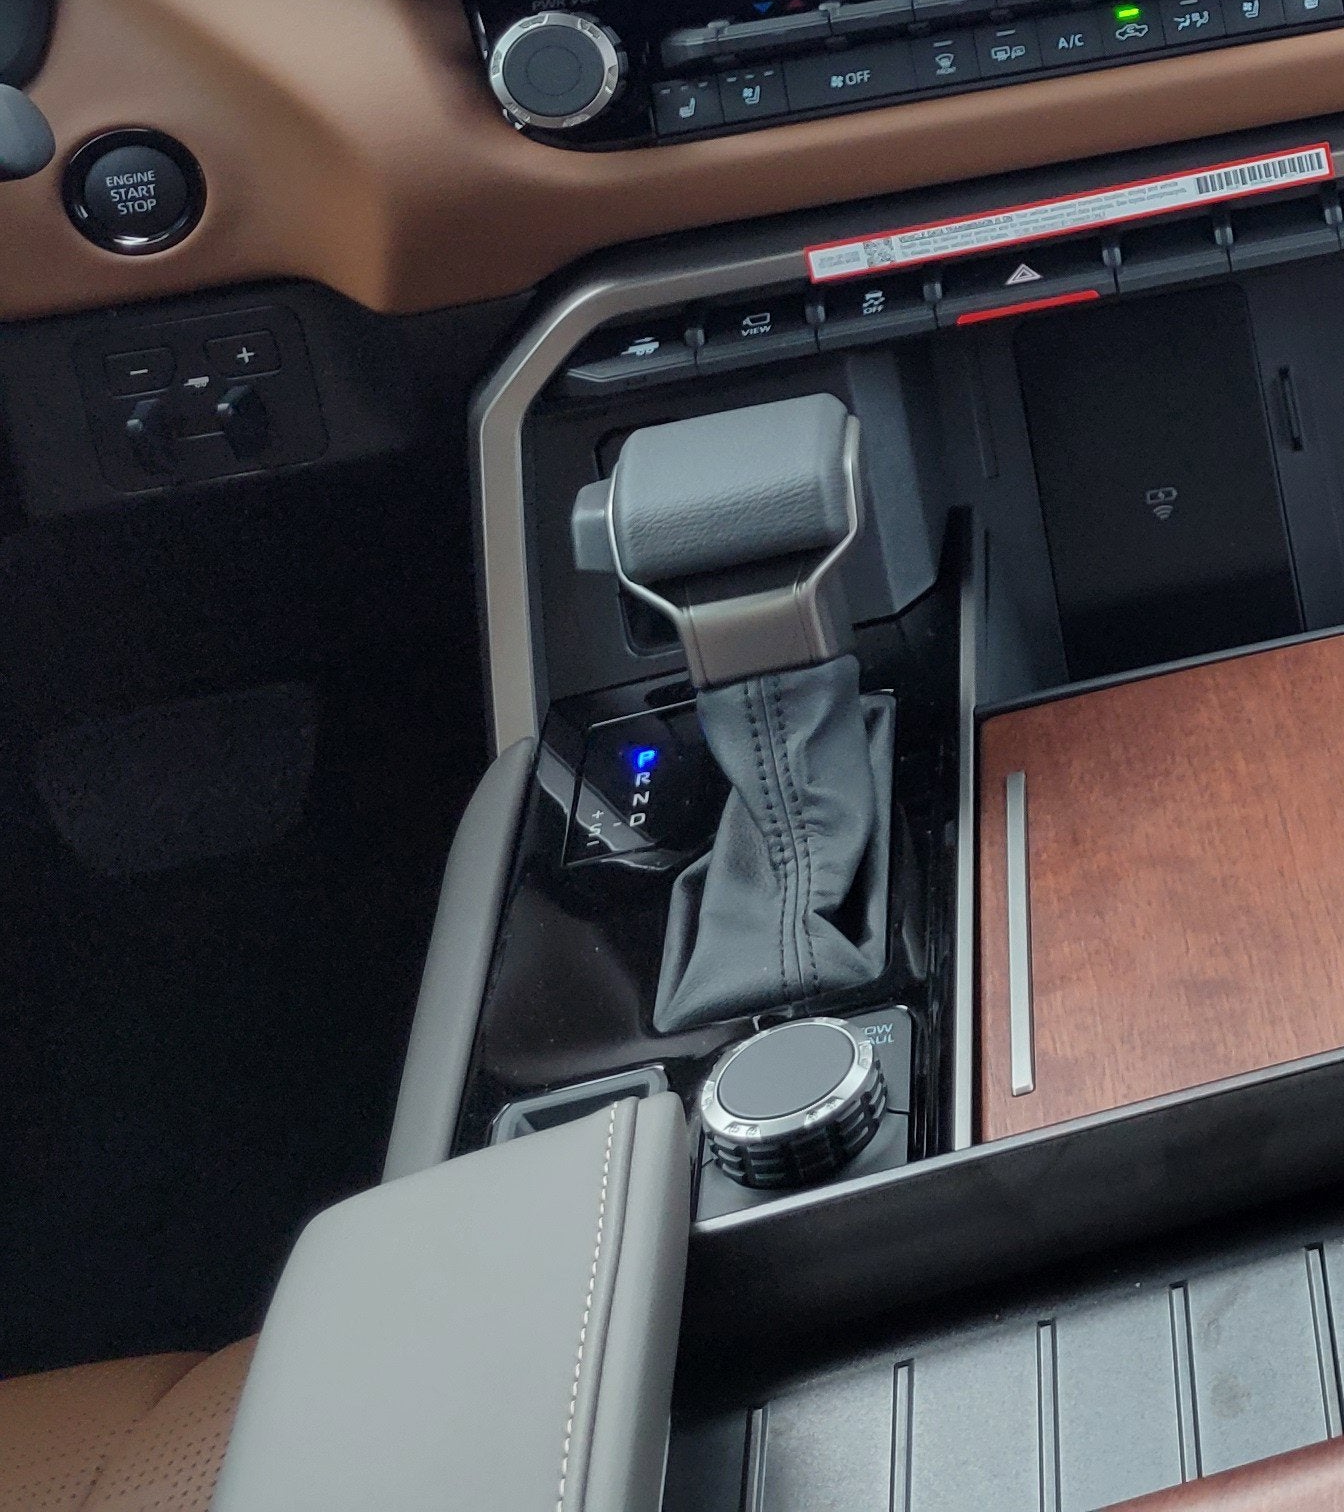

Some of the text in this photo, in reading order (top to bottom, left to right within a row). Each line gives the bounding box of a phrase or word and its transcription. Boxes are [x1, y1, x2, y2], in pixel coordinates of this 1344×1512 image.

[1058, 33, 1084, 49] A/C
[845, 69, 871, 86] OFF
[105, 170, 156, 187] ENGINE
[110, 183, 156, 202] START
[117, 198, 157, 215] STOP
[862, 304, 884, 316] OFF
[741, 324, 771, 337] VIEW
[637, 749, 656, 768] P
[635, 771, 652, 787] R
[632, 790, 650, 807] N
[629, 812, 646, 827] D
[863, 1023, 894, 1035] OW
